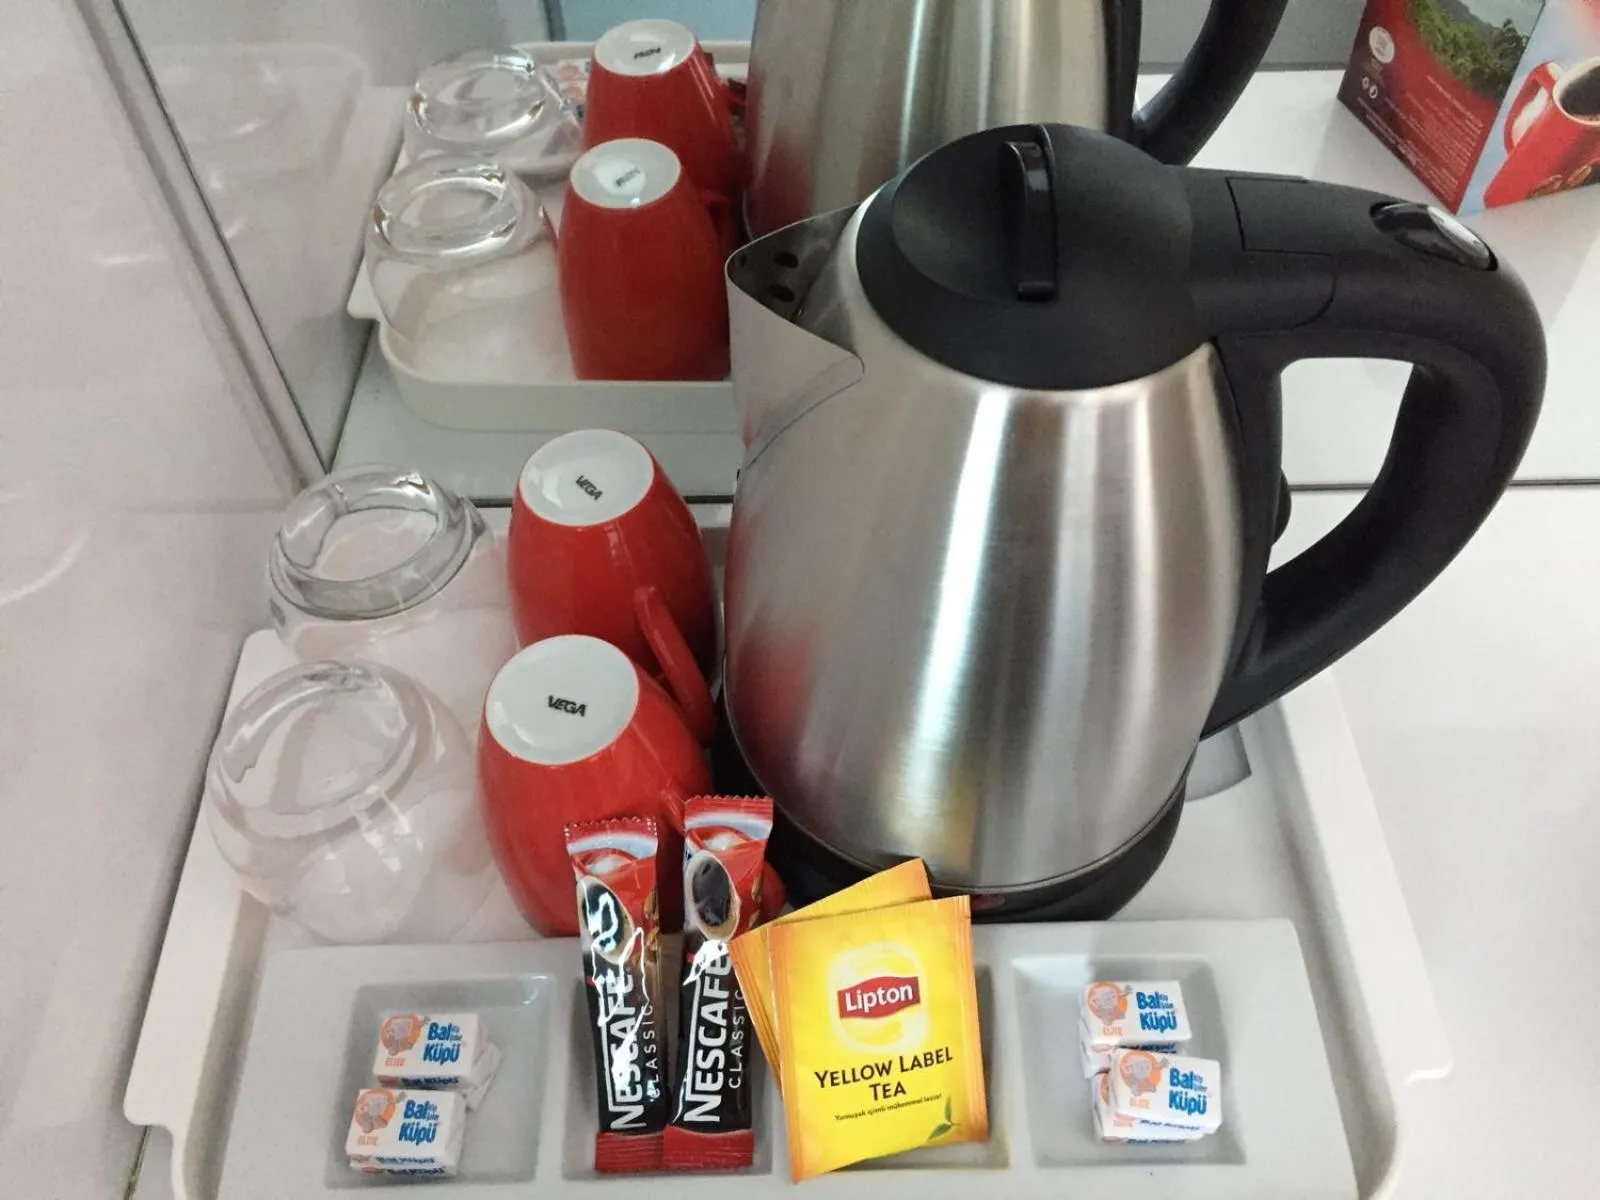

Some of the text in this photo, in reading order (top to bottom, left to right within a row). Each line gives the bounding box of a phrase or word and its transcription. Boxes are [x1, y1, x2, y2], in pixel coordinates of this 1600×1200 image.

[575, 475, 605, 501] VEGA
[548, 695, 588, 717] VEGA
[845, 984, 913, 1012] Lipton
[1136, 991, 1160, 1009] Bal
[428, 1022, 452, 1041] Bal
[1140, 1011, 1177, 1034] Küpü
[423, 1042, 461, 1066] Küpü
[814, 1047, 953, 1089] YELLOW LABEL
[1169, 1067, 1193, 1089] Bal
[869, 1081, 907, 1101] TEA
[1168, 1090, 1207, 1115] Küpü
[404, 1099, 429, 1120] Bal
[398, 1122, 437, 1146] Küpü
